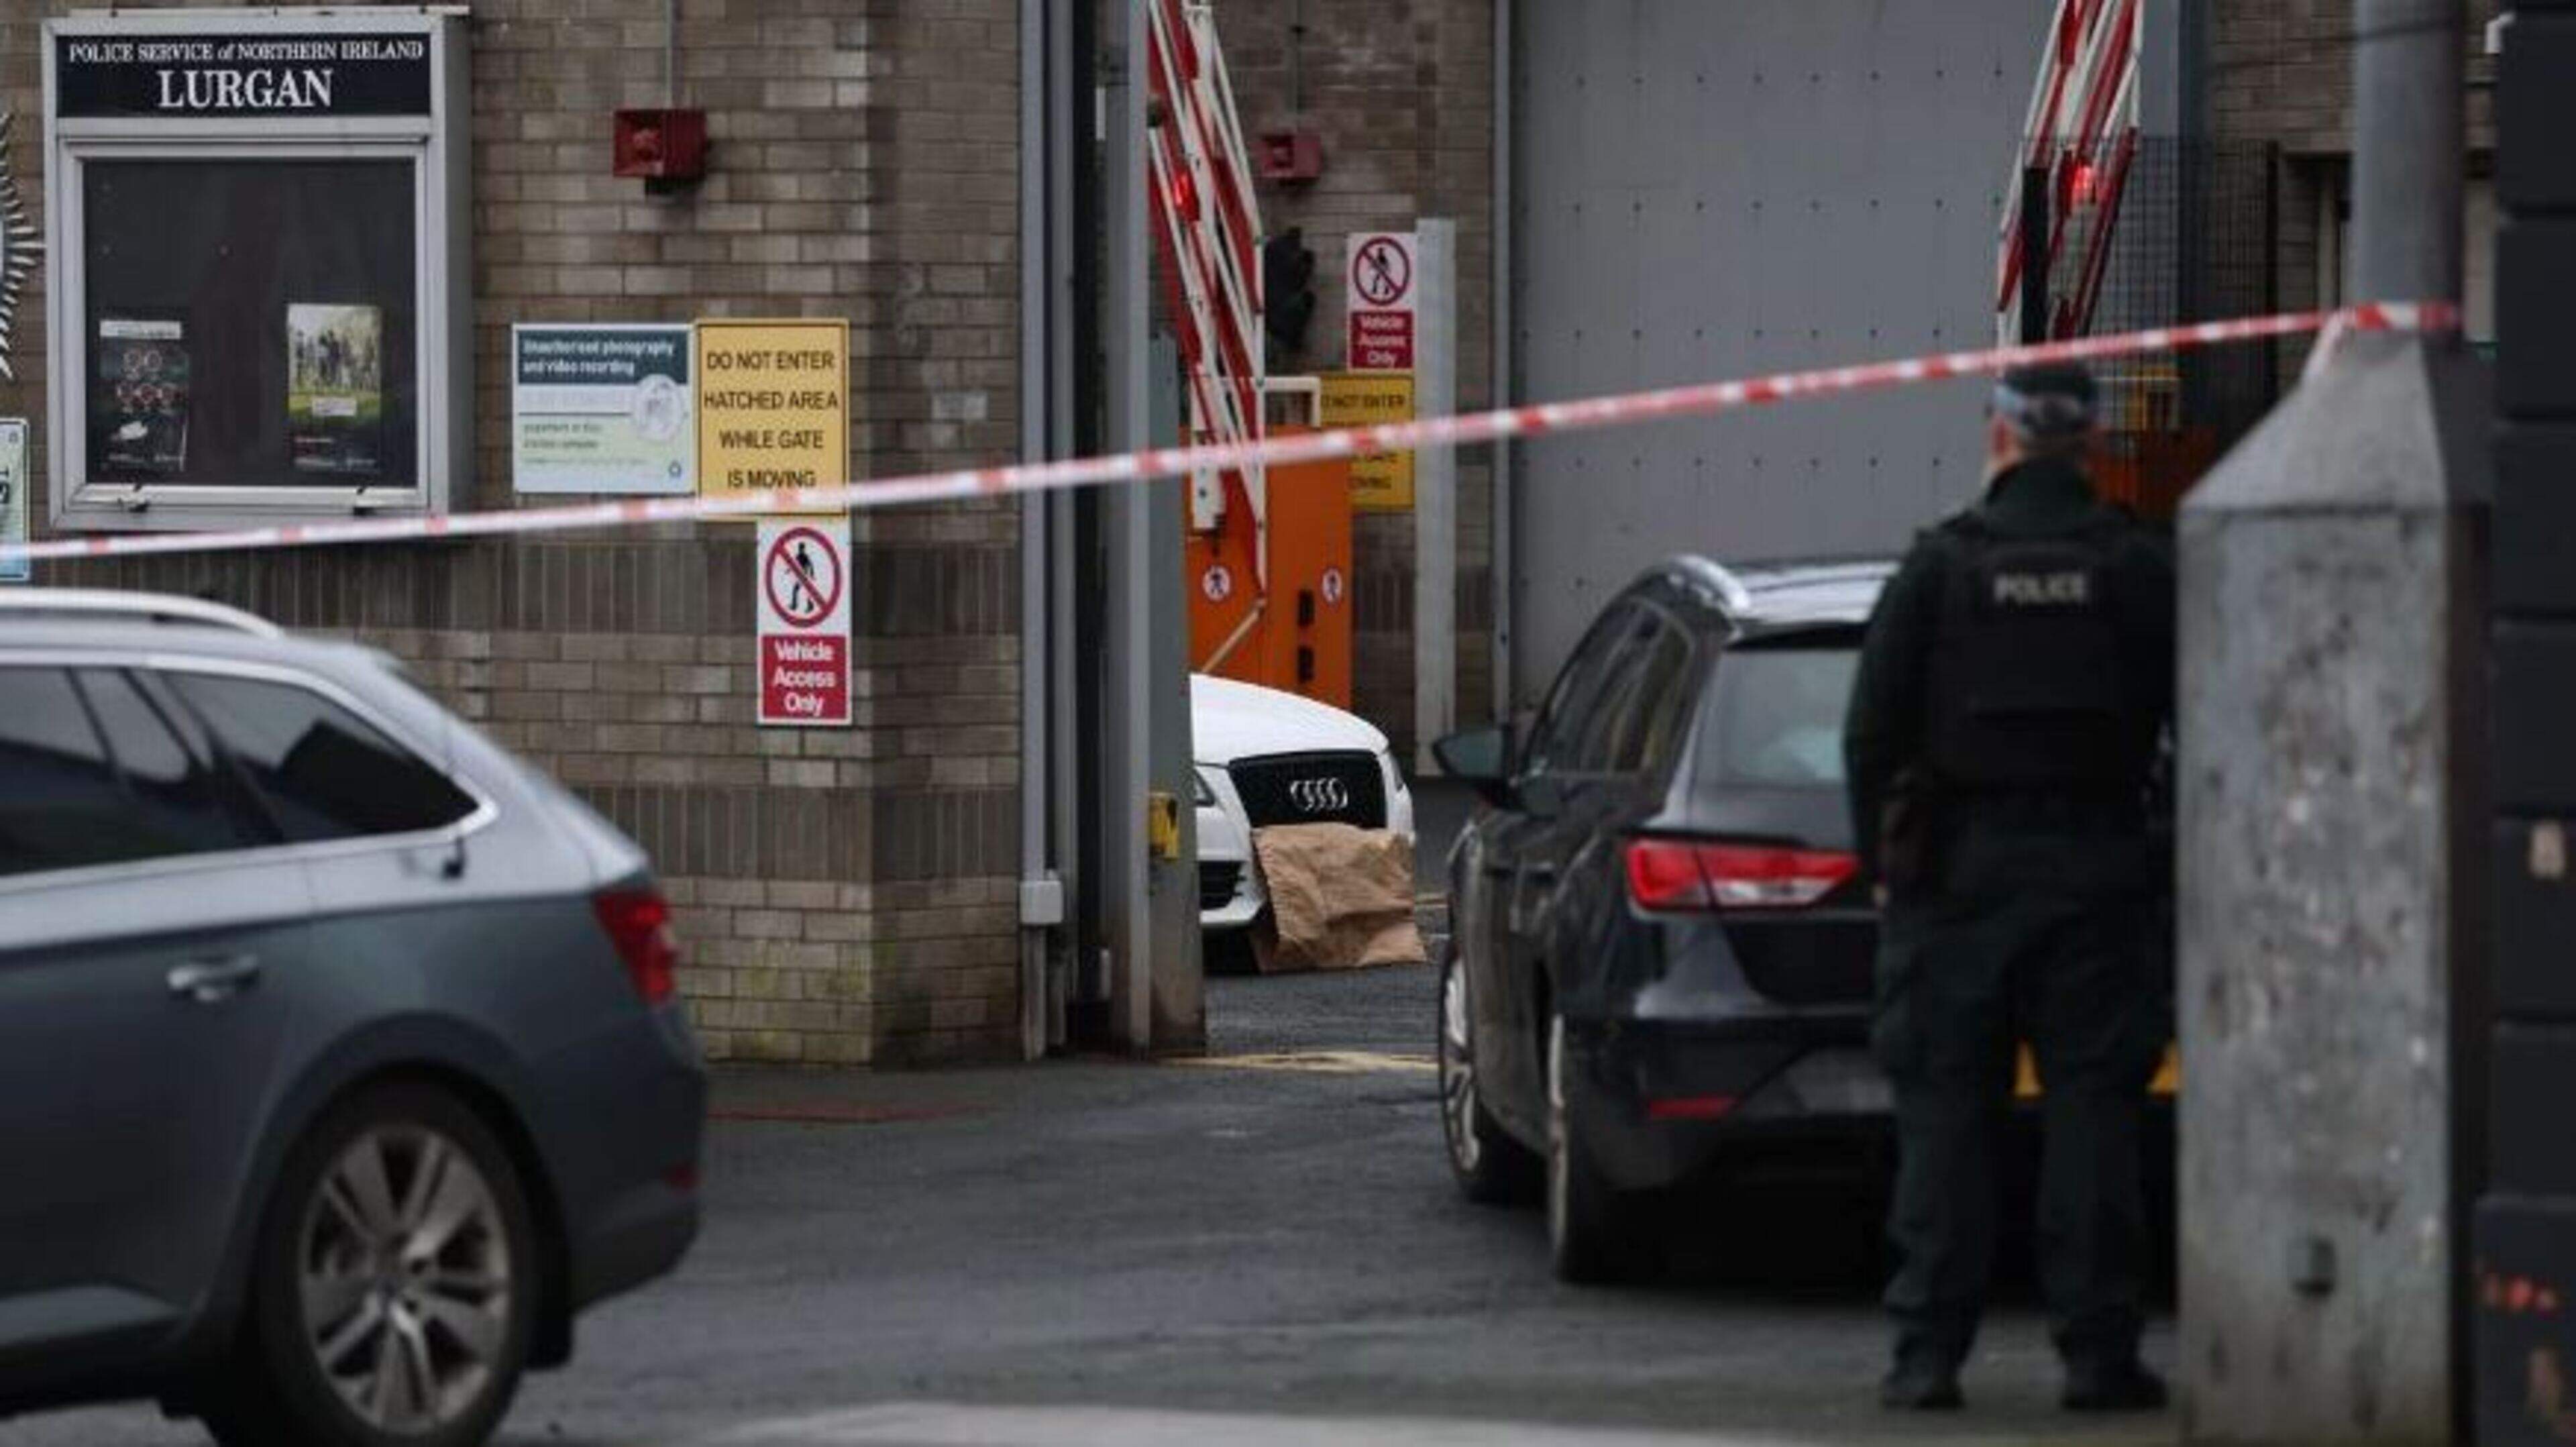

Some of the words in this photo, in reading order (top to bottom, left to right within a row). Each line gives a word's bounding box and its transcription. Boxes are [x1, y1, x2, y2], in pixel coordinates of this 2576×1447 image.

[69, 43, 135, 63] POLICE
[138, 42, 213, 62] SERVICE
[218, 42, 234, 61] of
[237, 42, 337, 61] NORTHERN
[341, 40, 423, 60] IRELAND
[158, 68, 335, 108] LURGAN
[1358, 315, 1405, 329] Vehicle
[604, 339, 674, 357] photography
[545, 358, 576, 374] video
[580, 359, 635, 377] recording
[706, 350, 733, 371] DO
[737, 350, 771, 370] NOT
[777, 350, 835, 370] ENTER
[1366, 350, 1396, 368] Only
[704, 390, 784, 410] HATCHED
[789, 390, 839, 410] AREA
[720, 429, 775, 449] WHILE
[778, 429, 825, 449] GATE
[727, 469, 744, 489] IS
[748, 468, 816, 489] MOVING
[1994, 573, 2086, 606] POLICE
[774, 640, 835, 661] Vehicle
[773, 667, 836, 688] Access
[783, 692, 824, 717] Only
